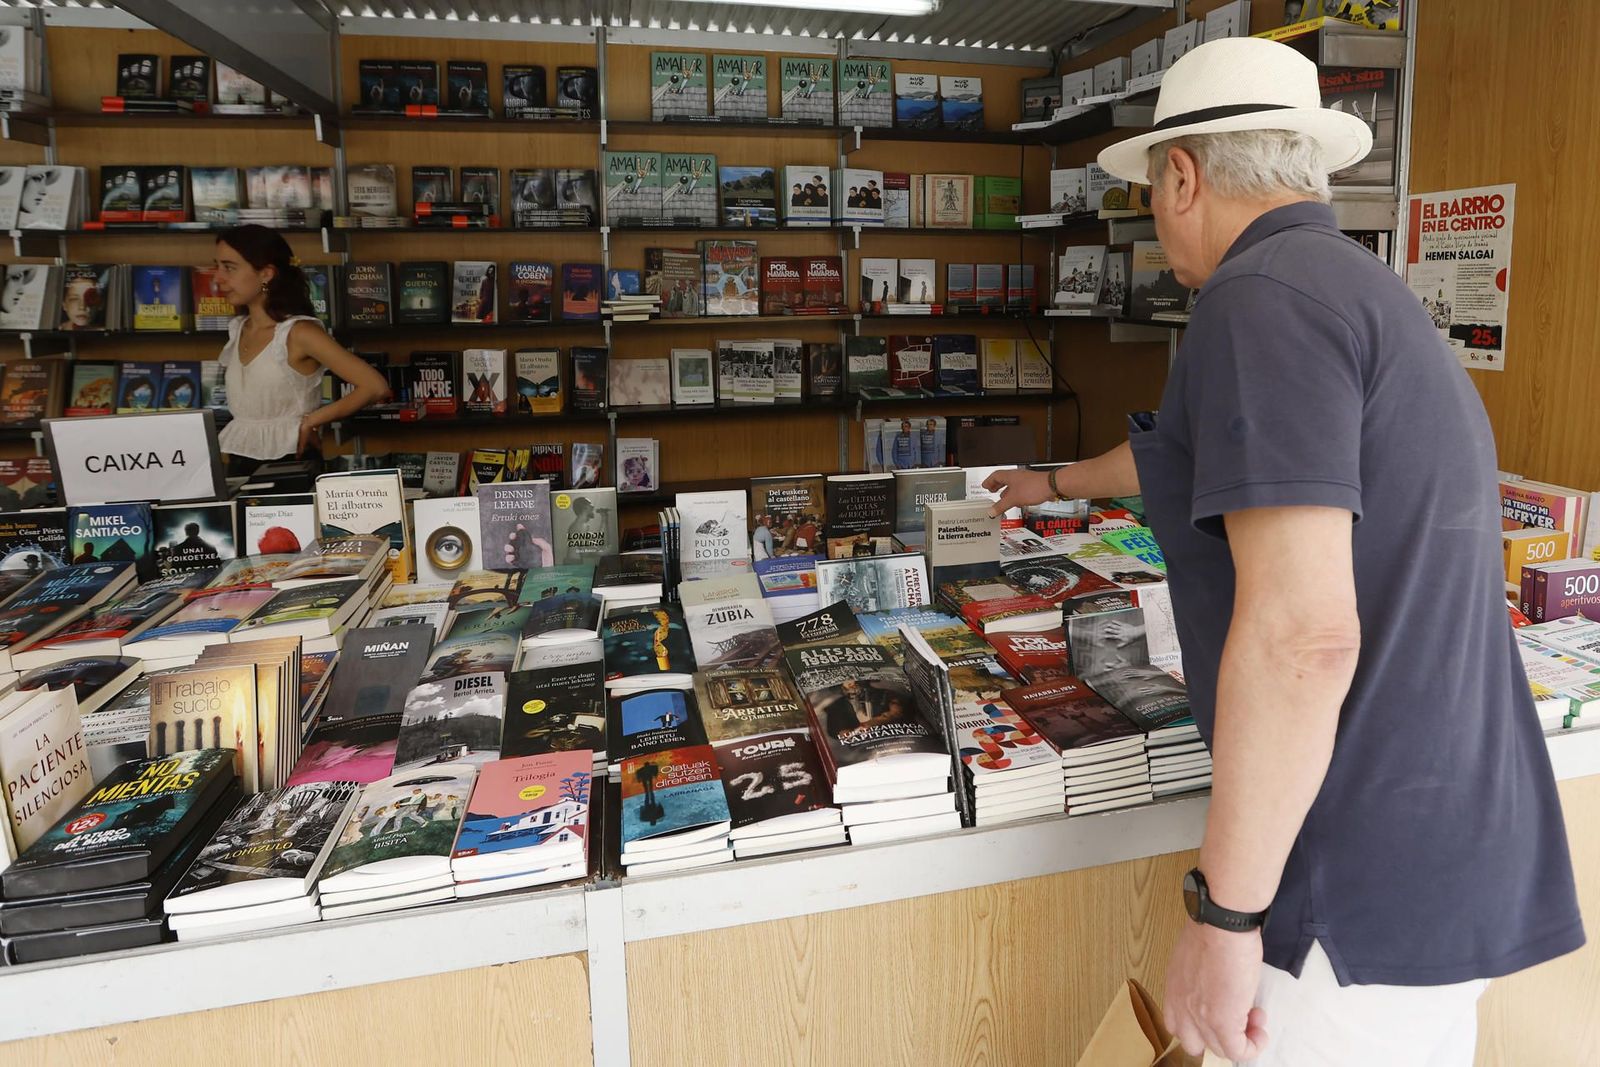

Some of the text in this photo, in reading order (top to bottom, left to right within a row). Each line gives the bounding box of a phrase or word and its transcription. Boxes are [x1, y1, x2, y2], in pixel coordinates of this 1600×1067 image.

[1423, 194, 1505, 220] EL BARRIO
[1422, 214, 1505, 233] EN EL CENTRO
[1425, 249, 1494, 261] HEMEN SALGAI
[356, 265, 376, 274] JOHN
[515, 264, 549, 274] HARLAN
[770, 263, 787, 271] POR
[807, 269, 840, 277] NAVARRA
[349, 273, 384, 281] GRISHAM
[518, 271, 546, 280] COBEN
[767, 270, 800, 278] NAVARRA
[419, 368, 444, 381] TODO
[413, 380, 452, 398] MUERE
[85, 450, 186, 474] CAIXA 4
[325, 489, 388, 499] María Oruña
[494, 489, 534, 500] DENNIS
[768, 494, 810, 503] al castellano
[782, 488, 808, 496] euskera
[327, 500, 383, 511] El albatros
[493, 500, 535, 510] LEHANE
[1513, 500, 1537, 512] TENGO
[1538, 506, 1548, 515] MI
[89, 516, 126, 527] MIKEL
[328, 511, 359, 521] negro
[19, 527, 64, 536] César Pérez
[75, 526, 142, 538] SANTIAGO
[938, 525, 970, 534] Palestina,
[1035, 521, 1045, 530] EL
[38, 534, 65, 542] Gellida
[567, 531, 605, 541] LONDON
[947, 532, 963, 540] tierra
[965, 530, 992, 539] estrecha
[567, 539, 605, 548] CALLING
[695, 538, 730, 548] PUNTO
[166, 553, 221, 562] GOIKOETXEA
[695, 548, 730, 559] BOBO
[1526, 541, 1556, 561] 500
[68, 567, 89, 578] LA
[42, 575, 96, 589] MUJER
[911, 567, 923, 607] ATREVERS
[1564, 574, 1600, 597] 500
[1560, 594, 1600, 608] aperitivos
[706, 608, 754, 626] ZUBIA
[796, 613, 834, 632] 778
[364, 641, 410, 654] MIÑAN
[1008, 640, 1067, 652] NAVAR
[1010, 637, 1050, 646] POR
[800, 646, 878, 659] ALTSASU
[164, 676, 231, 700] Trabajo
[453, 675, 493, 692] DIESEL
[453, 687, 496, 698] Bertol Arrieta
[172, 695, 221, 716] sucio
[954, 718, 995, 731] AVARRA
[35, 732, 50, 751] LA
[631, 736, 686, 750] BAINO LEHEN
[639, 733, 676, 743] LEHERTU
[840, 729, 915, 746] KAPITAINA
[8, 732, 82, 801] PACIENTE
[139, 759, 180, 782] NO
[660, 760, 711, 774] Olatuak
[667, 767, 712, 780] sutzen
[655, 773, 713, 789] direnean
[15, 761, 88, 828] SILENCIOSA
[86, 771, 200, 805] MIENTAS
[53, 839, 82, 851] DEL
[82, 832, 131, 848] BURGO
[71, 827, 128, 844] ARTURO
[373, 836, 409, 849] BISITA
[223, 841, 293, 860] LOHIZULO
